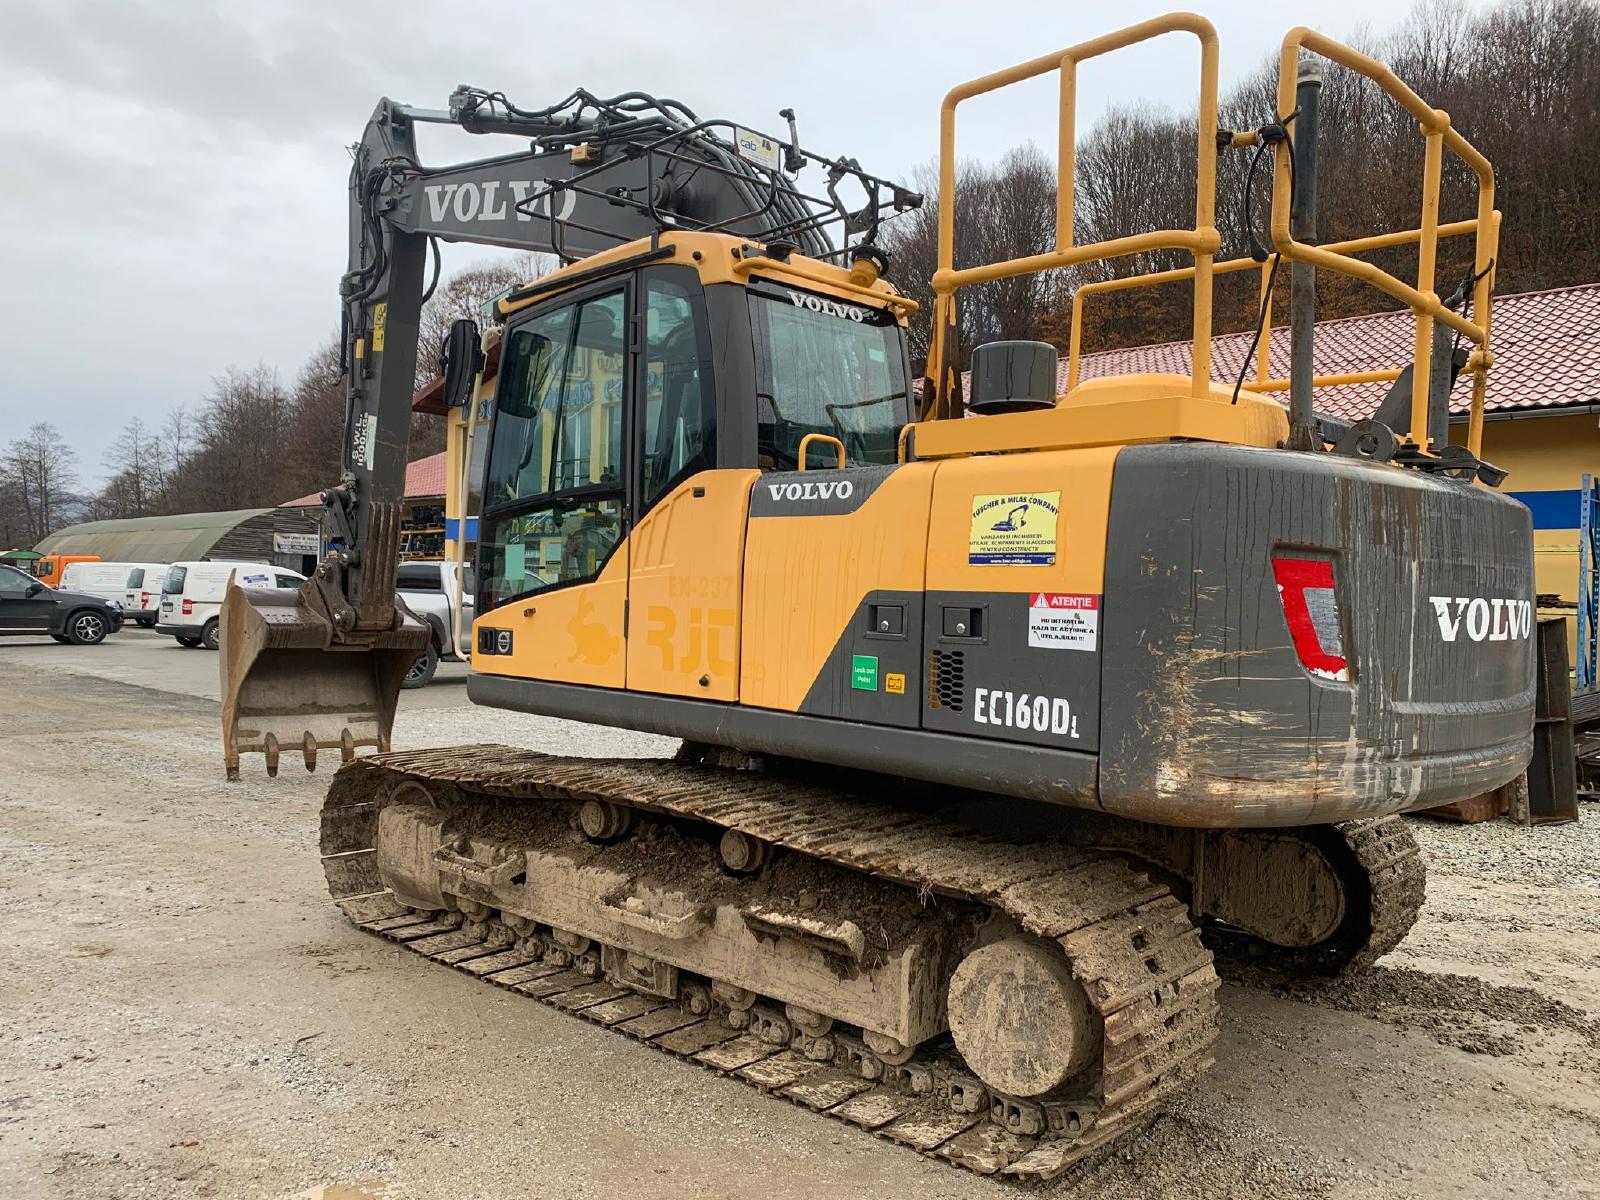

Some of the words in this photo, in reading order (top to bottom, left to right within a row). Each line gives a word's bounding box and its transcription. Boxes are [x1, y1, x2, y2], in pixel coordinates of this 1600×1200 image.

[424, 179, 577, 222] VOLVO
[787, 290, 863, 322] VOLVO
[768, 480, 853, 501] VOLVO
[972, 500, 999, 518] TUSCHER
[1028, 497, 1059, 516] COMPANY
[1429, 596, 1531, 641] VOLVO
[854, 666, 866, 674] Lock
[857, 675, 871, 684] Point
